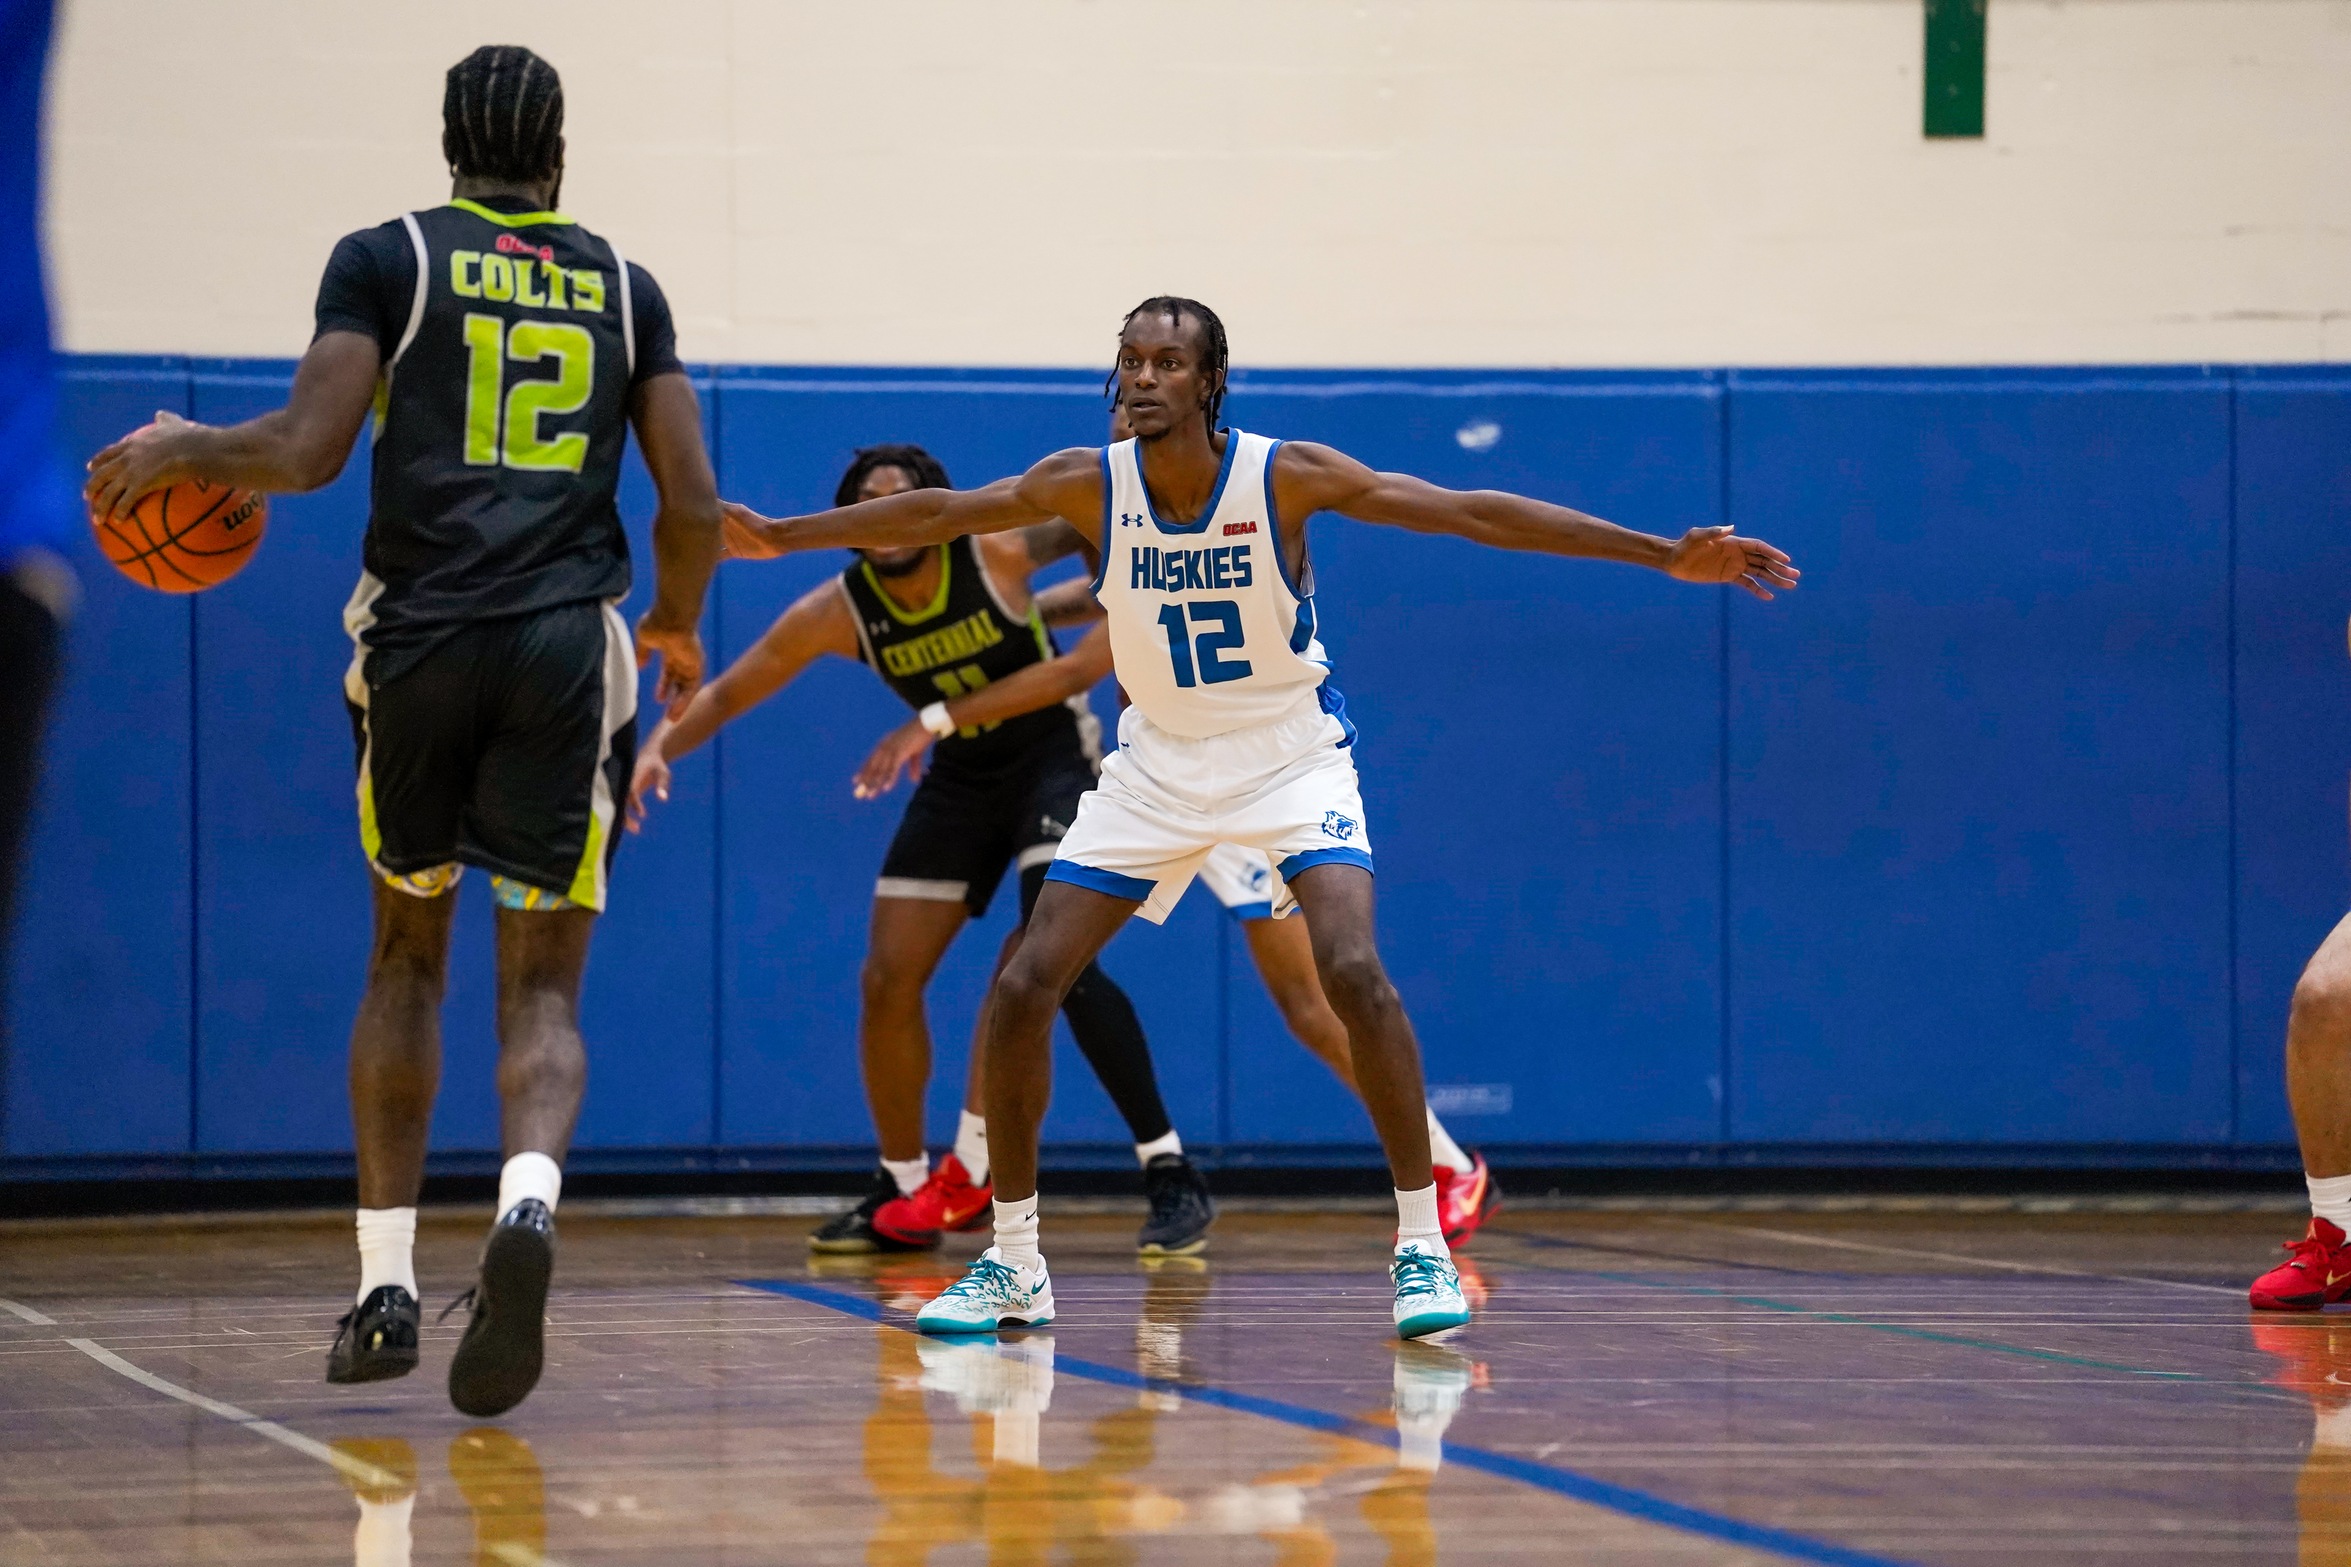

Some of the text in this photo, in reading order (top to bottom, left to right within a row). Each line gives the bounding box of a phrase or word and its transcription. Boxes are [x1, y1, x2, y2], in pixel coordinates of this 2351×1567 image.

[451, 249, 606, 313] COLTS
[463, 312, 595, 474] 12
[1222, 521, 1258, 537] OCAA
[1131, 545, 1253, 593] HUSKIES
[881, 608, 1004, 677] CENTENNIAL
[1157, 600, 1253, 688] 12
